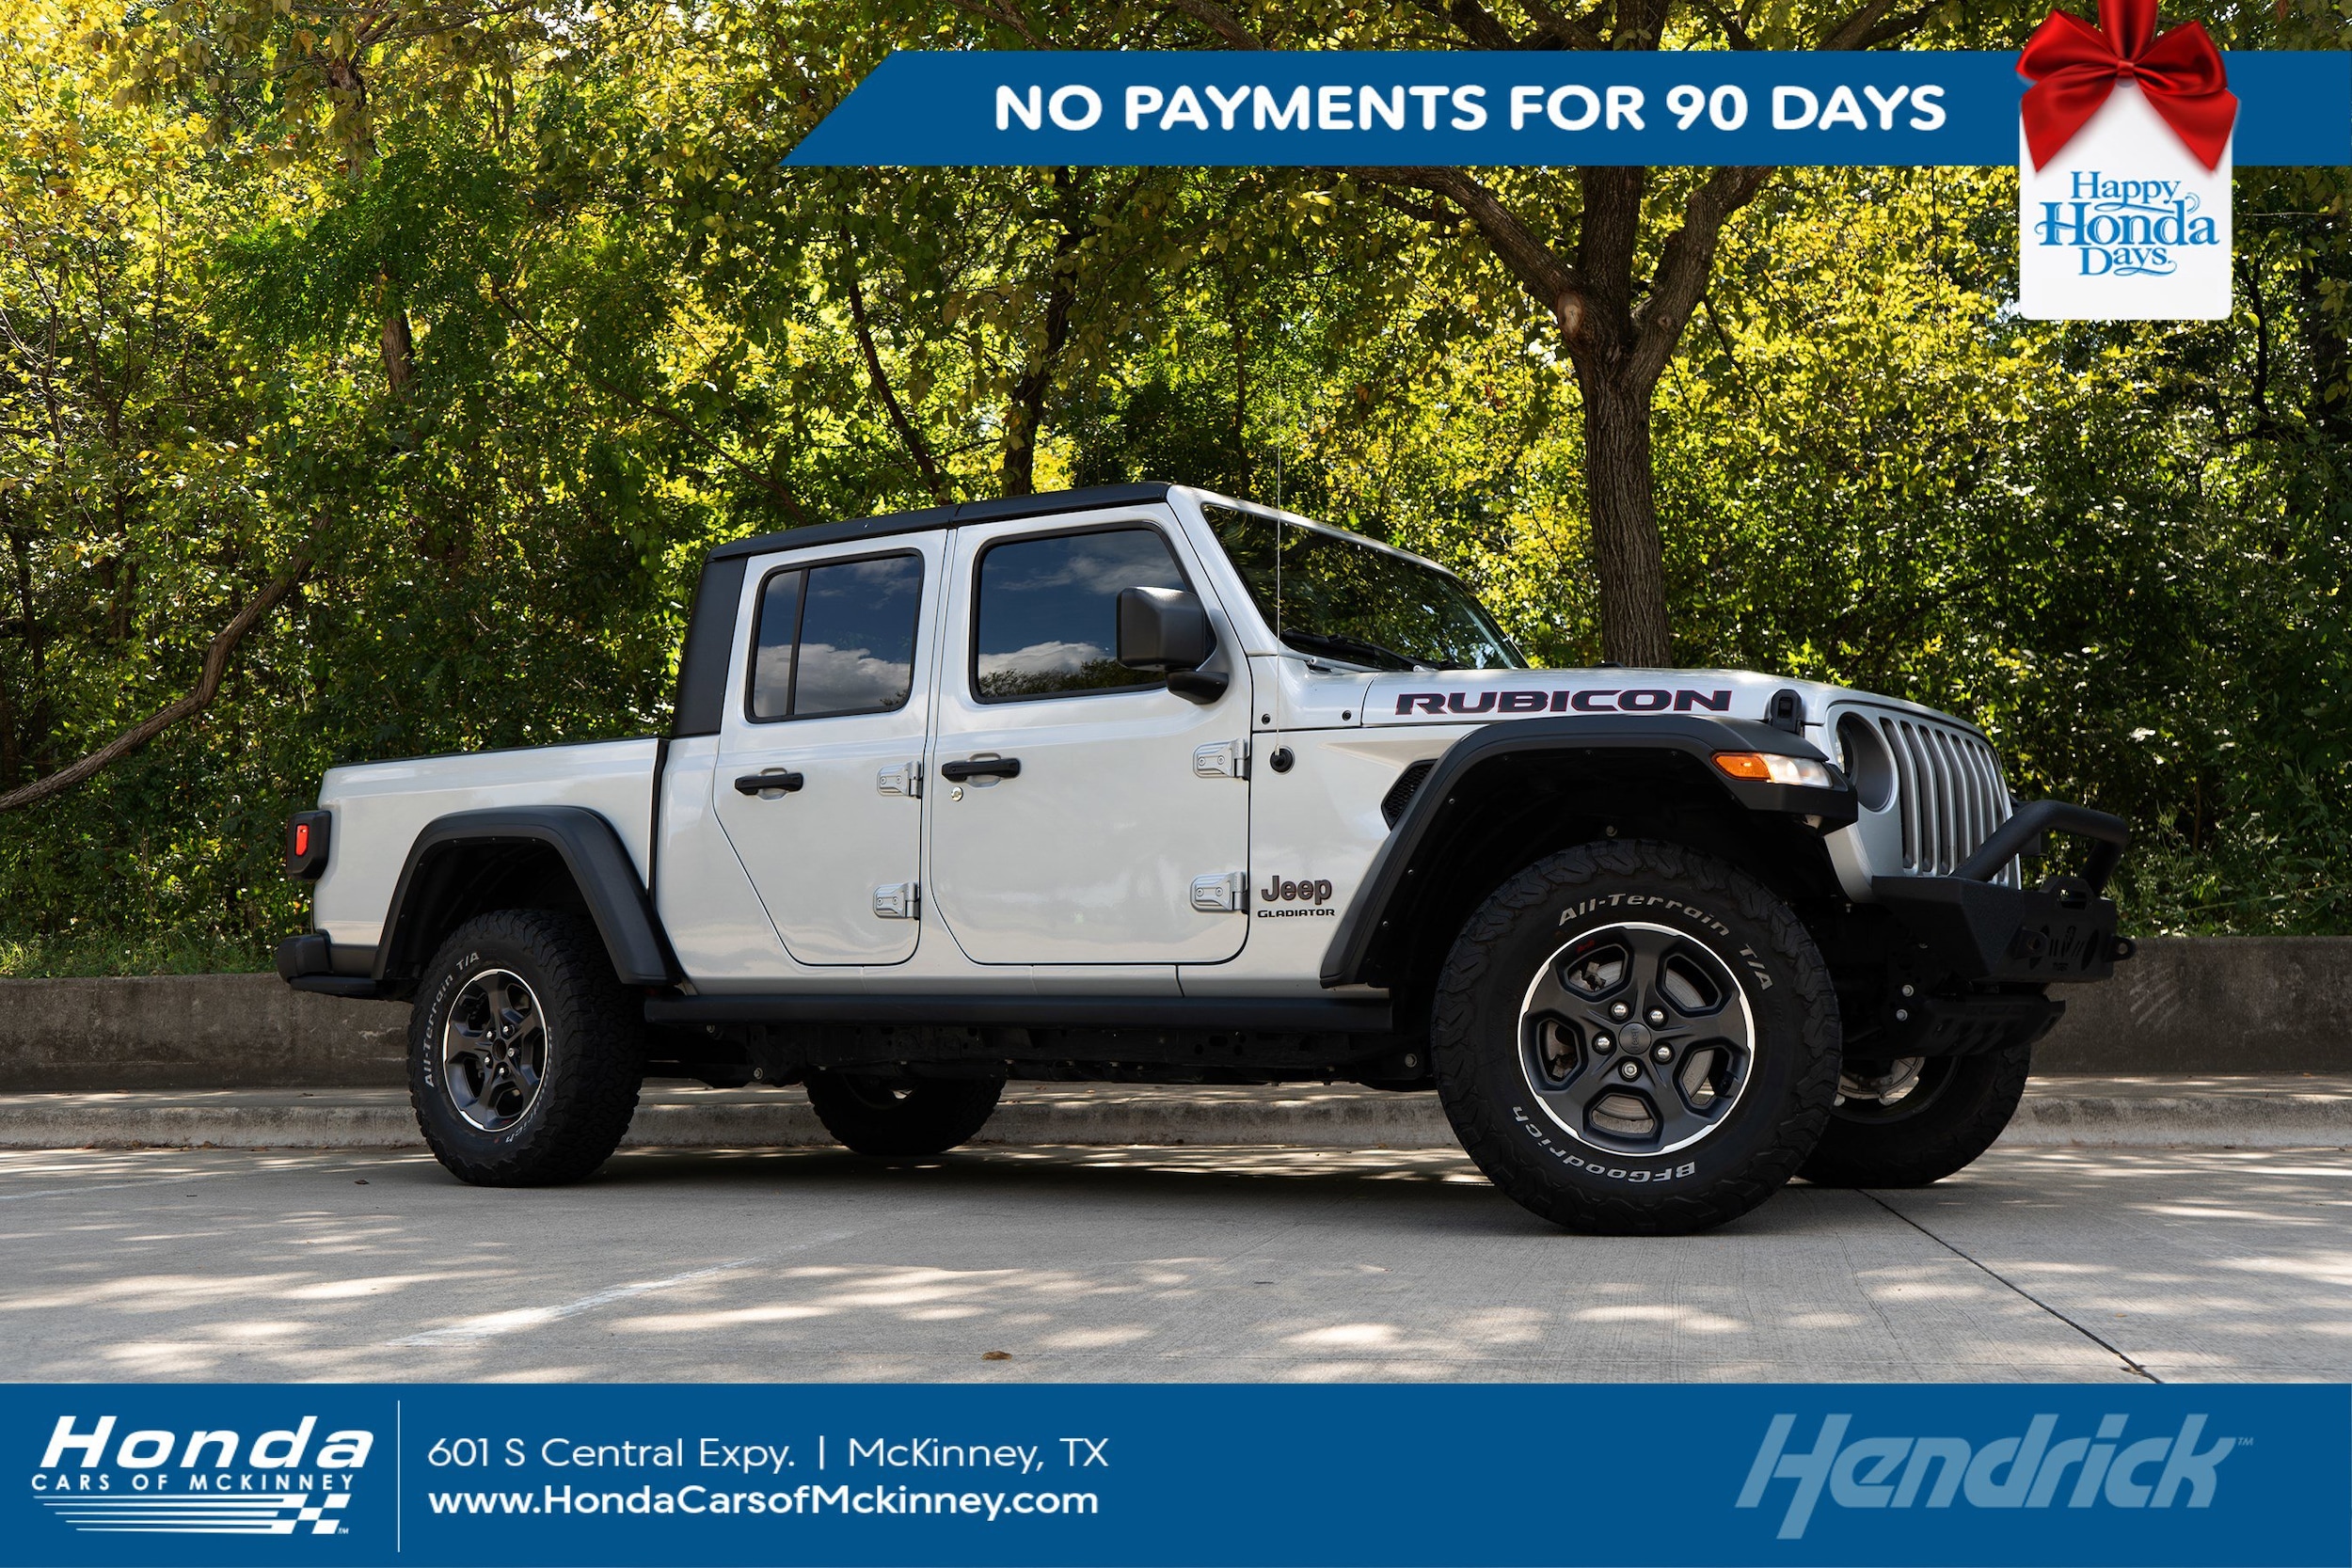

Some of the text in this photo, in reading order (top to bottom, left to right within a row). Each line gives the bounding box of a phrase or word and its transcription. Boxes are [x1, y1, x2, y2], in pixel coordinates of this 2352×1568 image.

[1395, 689, 1732, 716] RUBICON
[1257, 909, 1335, 918] GLADIATOR
[1261, 875, 1332, 905] Jeep
[1558, 892, 1775, 991] All-Terrain T/A
[421, 952, 481, 1088] All-Terrain T/A
[1512, 1105, 1697, 1183] BFGoodrich
